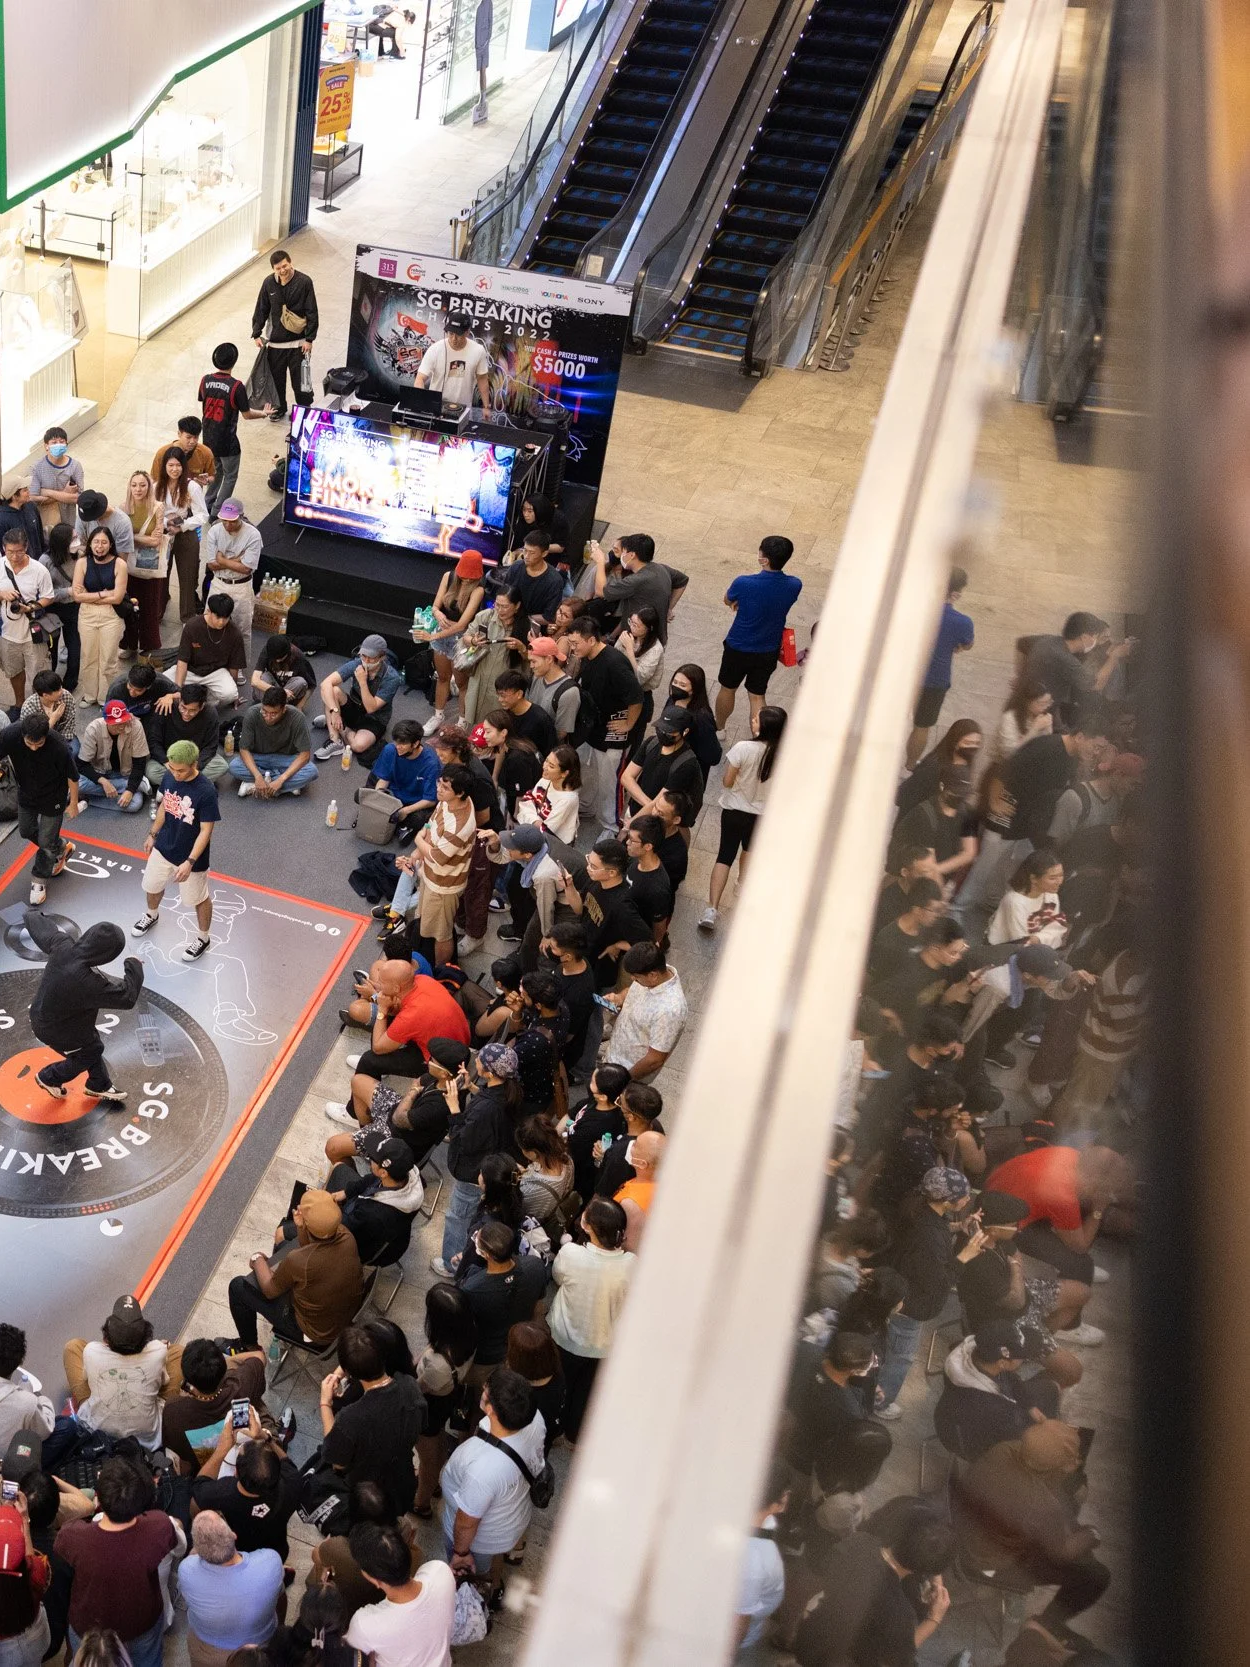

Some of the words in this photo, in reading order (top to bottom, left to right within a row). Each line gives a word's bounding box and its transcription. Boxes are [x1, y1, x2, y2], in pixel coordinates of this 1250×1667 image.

[381, 262, 395, 272] 313
[435, 278, 463, 286] OAKLEY
[577, 297, 605, 306] SONY
[504, 324, 551, 341] 2022
[537, 347, 552, 355] CASH
[558, 351, 577, 361] PRIZES
[578, 355, 599, 364] WORTH
[533, 354, 586, 380] $5000
[205, 381, 230, 393] VADER
